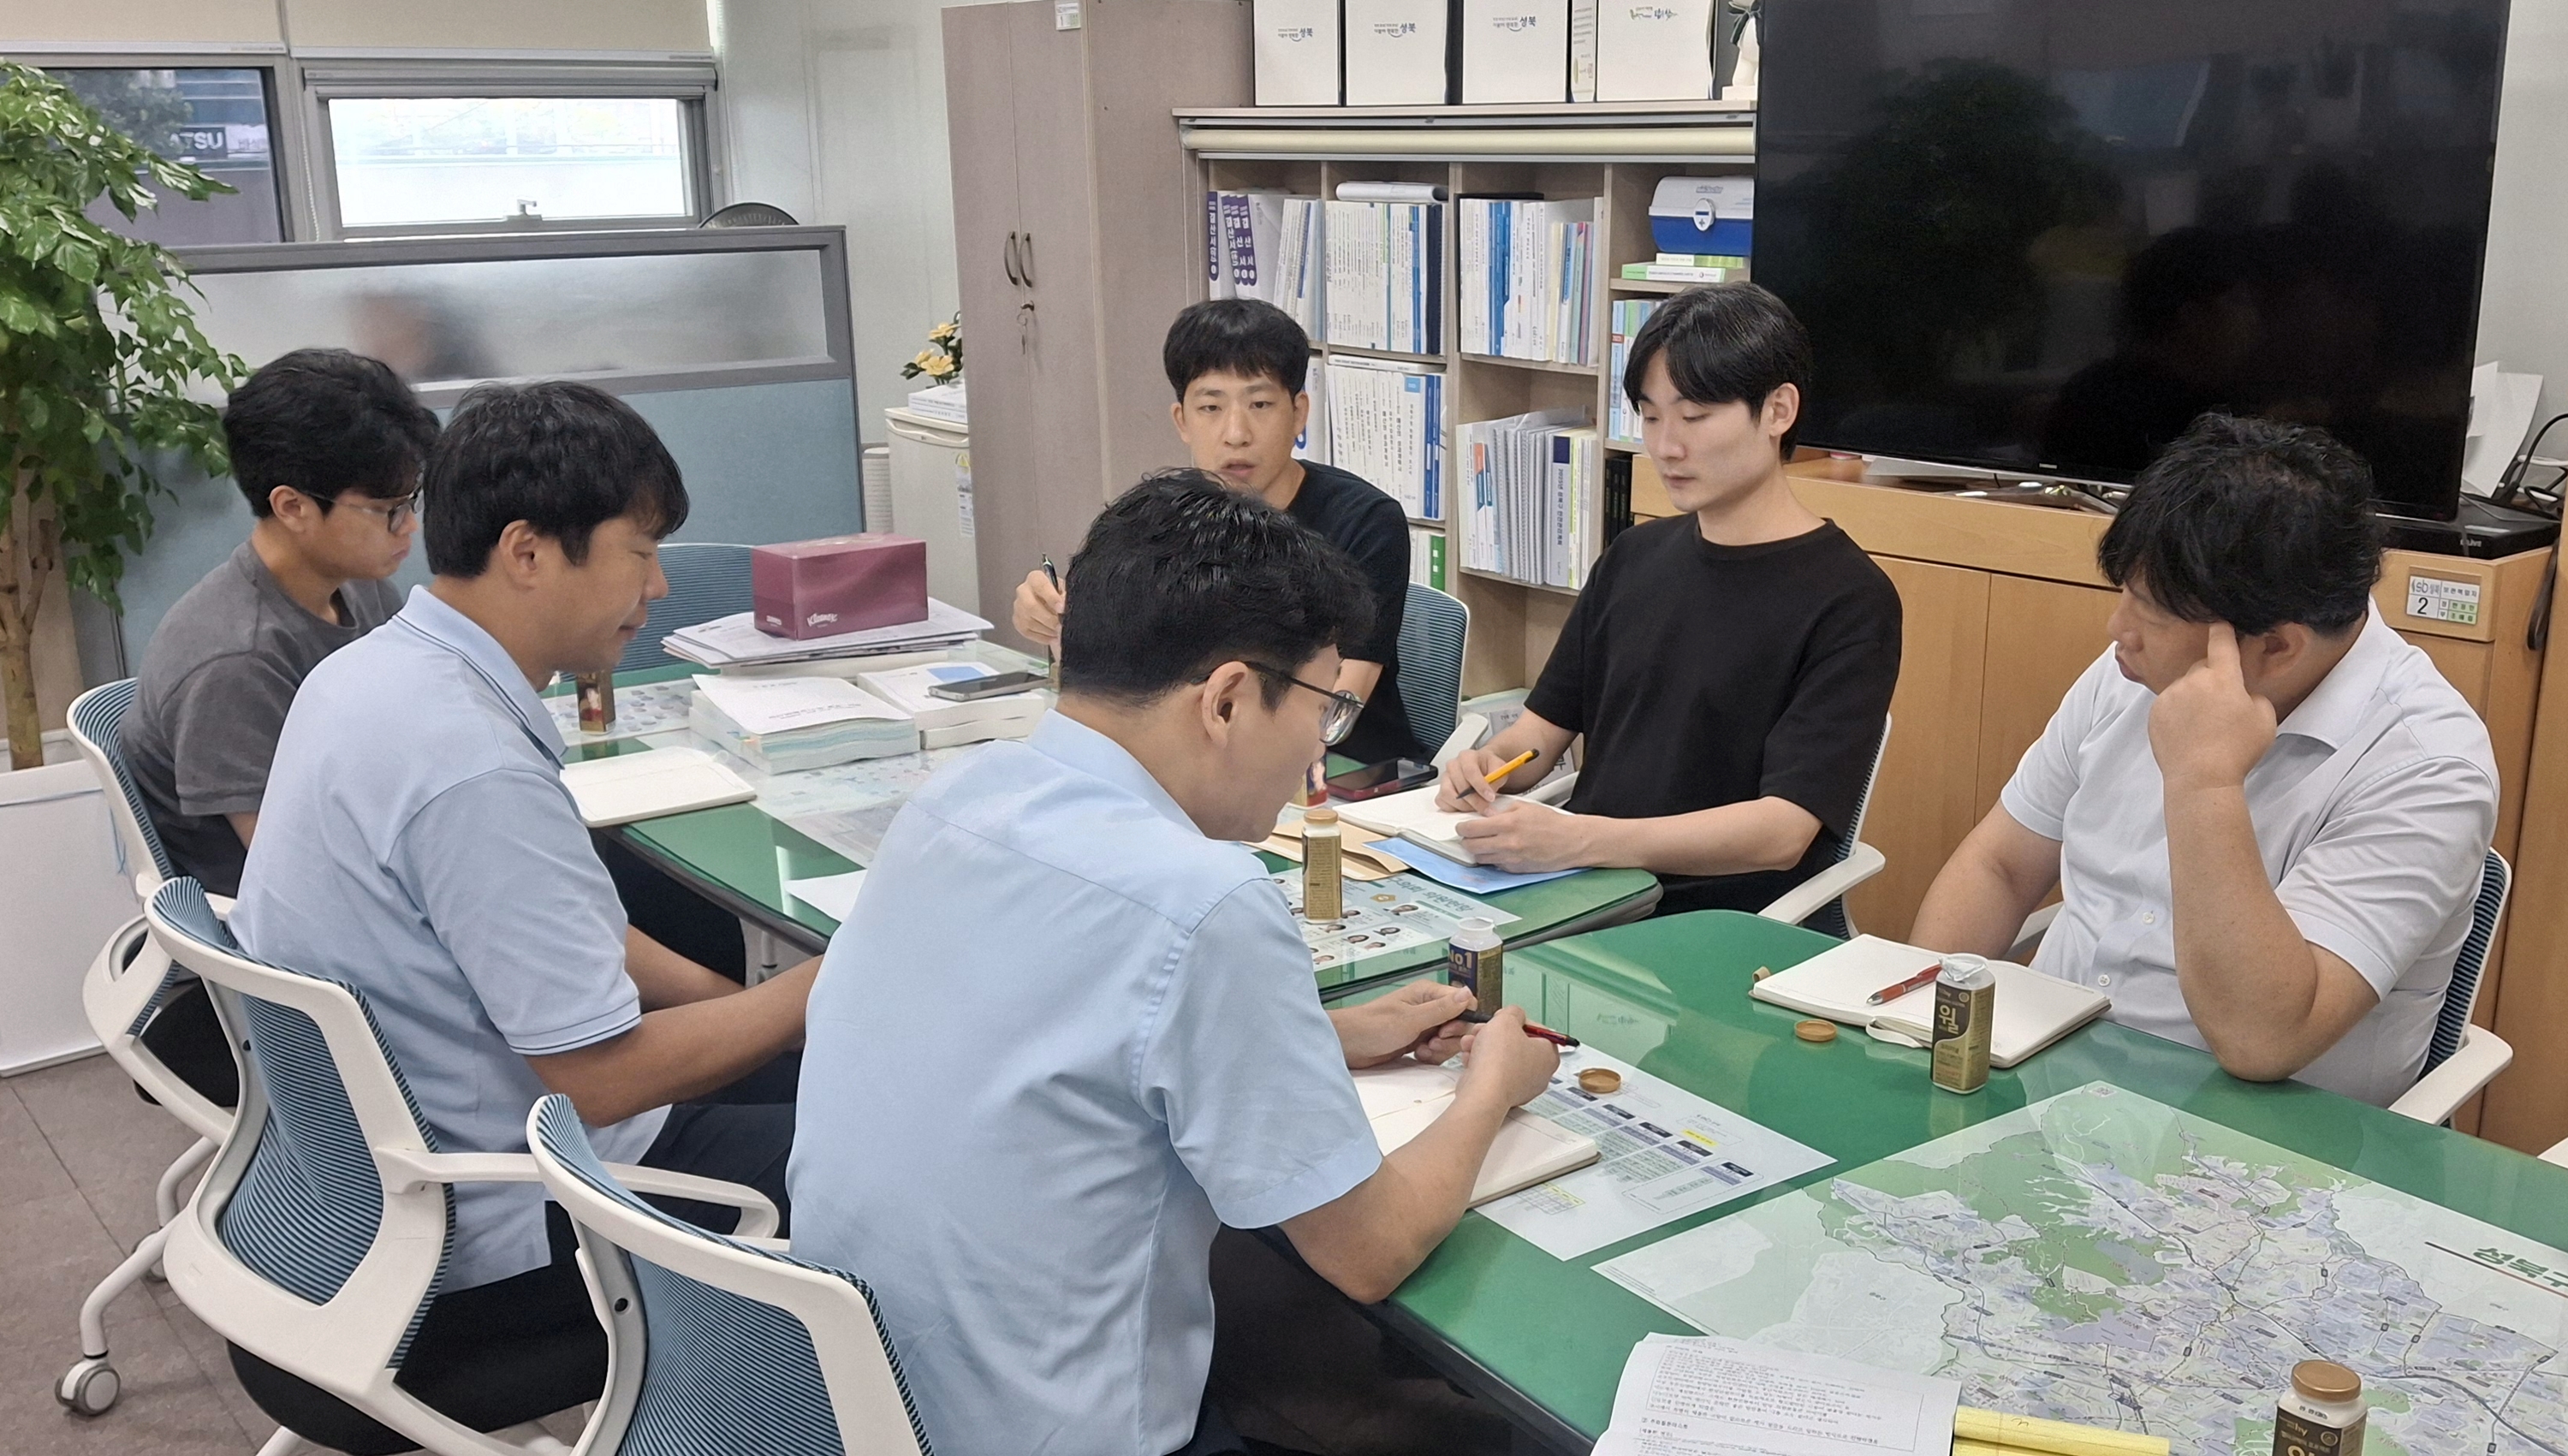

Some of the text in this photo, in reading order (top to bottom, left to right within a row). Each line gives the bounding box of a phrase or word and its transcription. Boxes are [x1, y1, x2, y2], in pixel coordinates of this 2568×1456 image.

[1400, 22, 1416, 33] 성북
[1519, 15, 1536, 27] 성북
[1299, 27, 1313, 38] 성북
[2416, 597, 2428, 615] 2
[1938, 1004, 1959, 1035] 윌
[2473, 1247, 2568, 1288] 성북구
